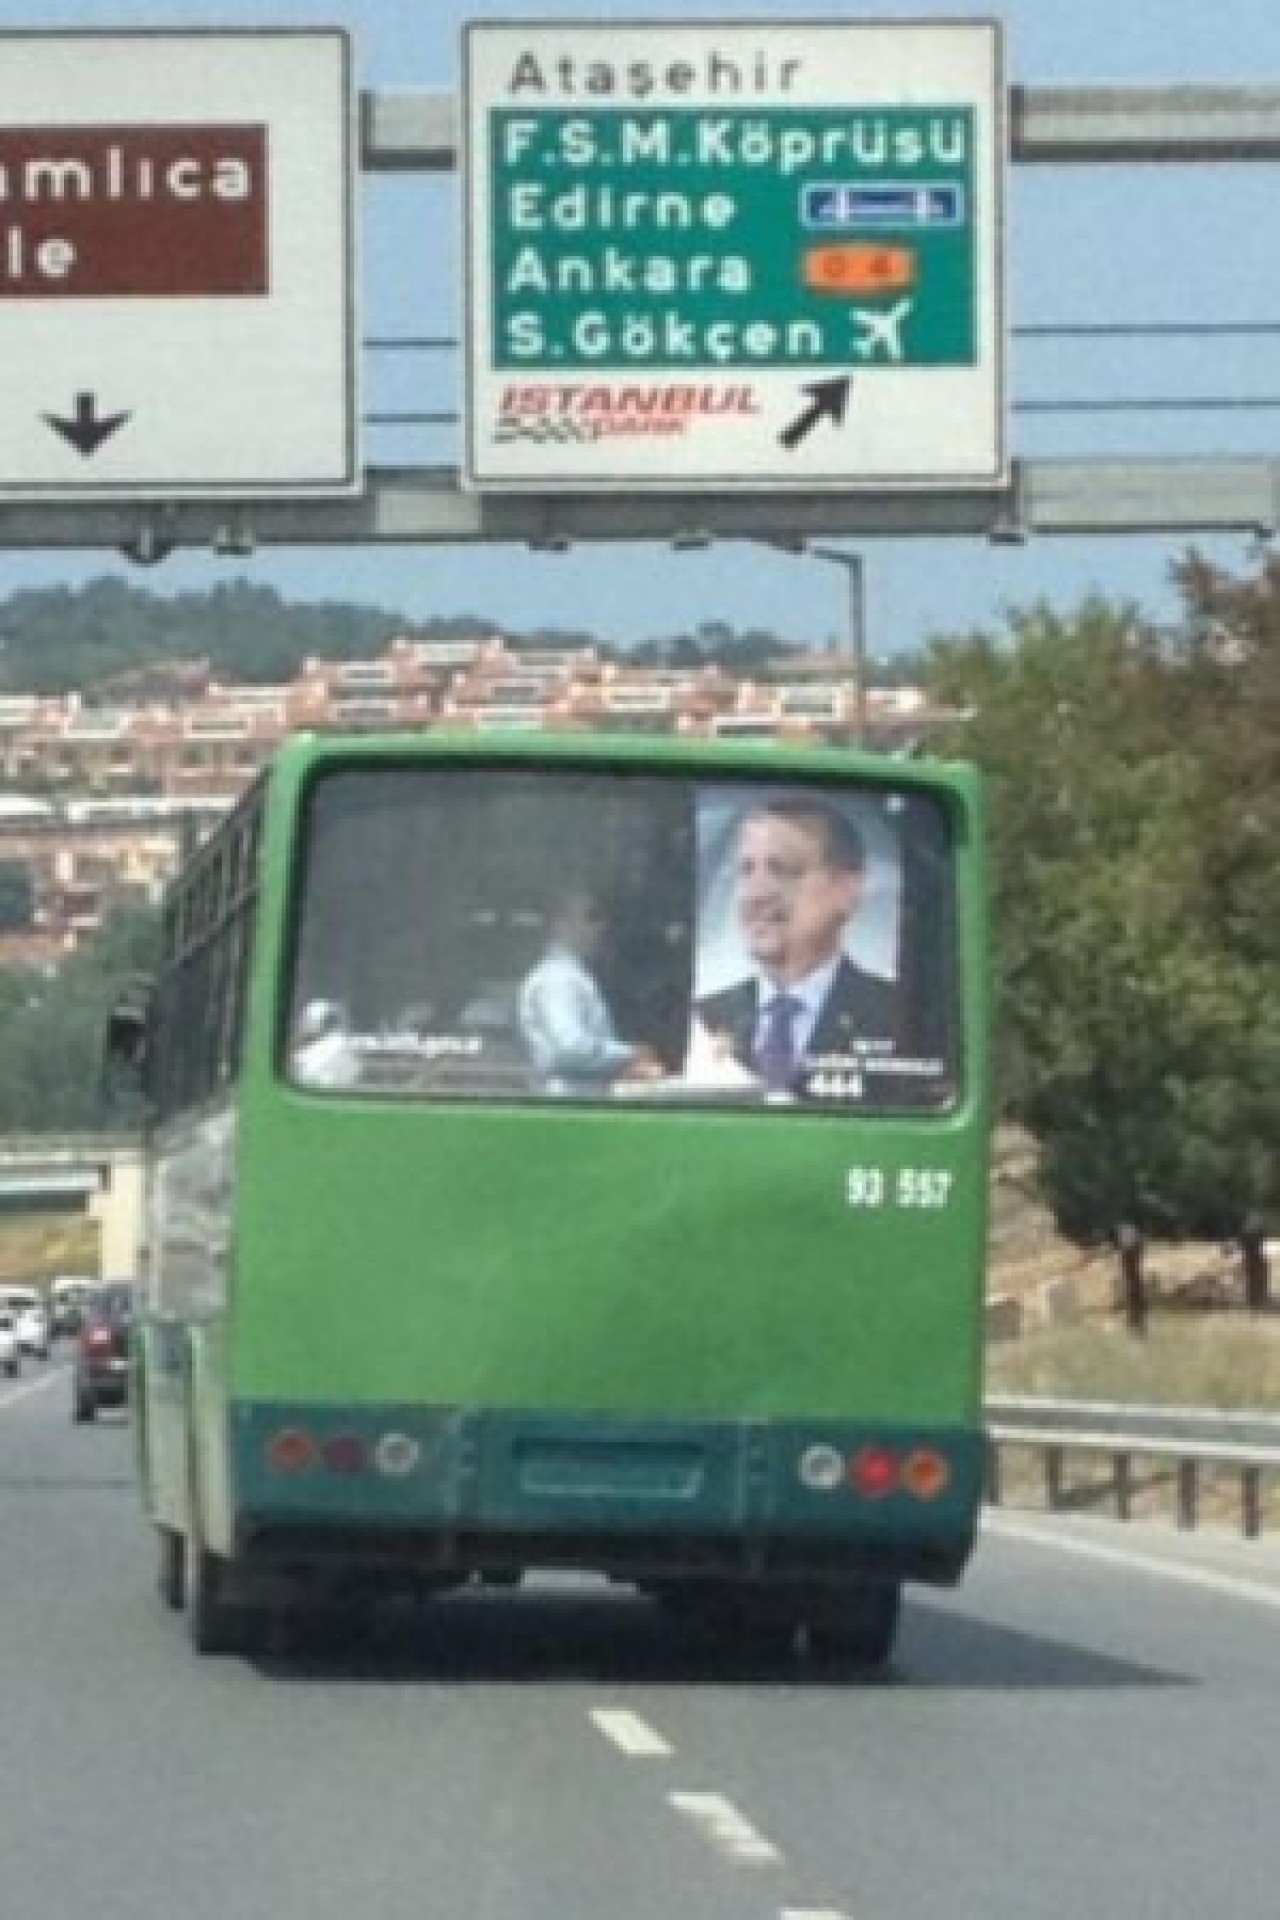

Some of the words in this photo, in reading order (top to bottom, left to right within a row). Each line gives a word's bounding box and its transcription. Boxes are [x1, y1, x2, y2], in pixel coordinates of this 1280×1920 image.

[508, 50, 802, 96] Ataşehir
[509, 183, 736, 230] Edirne
[508, 246, 751, 293] Ankara
[506, 310, 824, 361] S.Gökçen
